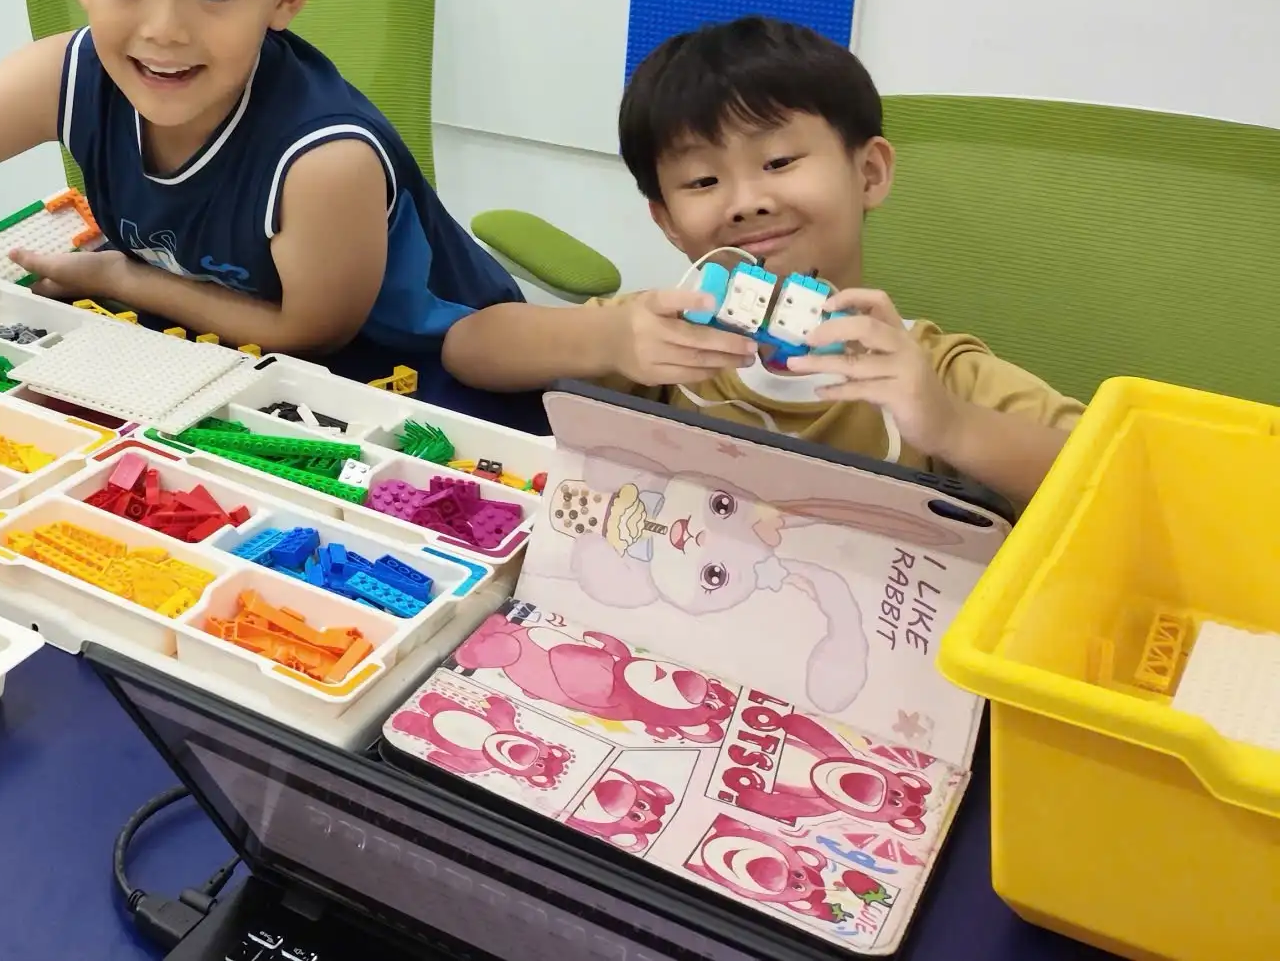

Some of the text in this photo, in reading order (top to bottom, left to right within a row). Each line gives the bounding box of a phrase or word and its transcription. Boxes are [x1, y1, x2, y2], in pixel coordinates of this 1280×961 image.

[876, 546, 916, 651] RABBIT
[905, 555, 947, 656] I LIKE
